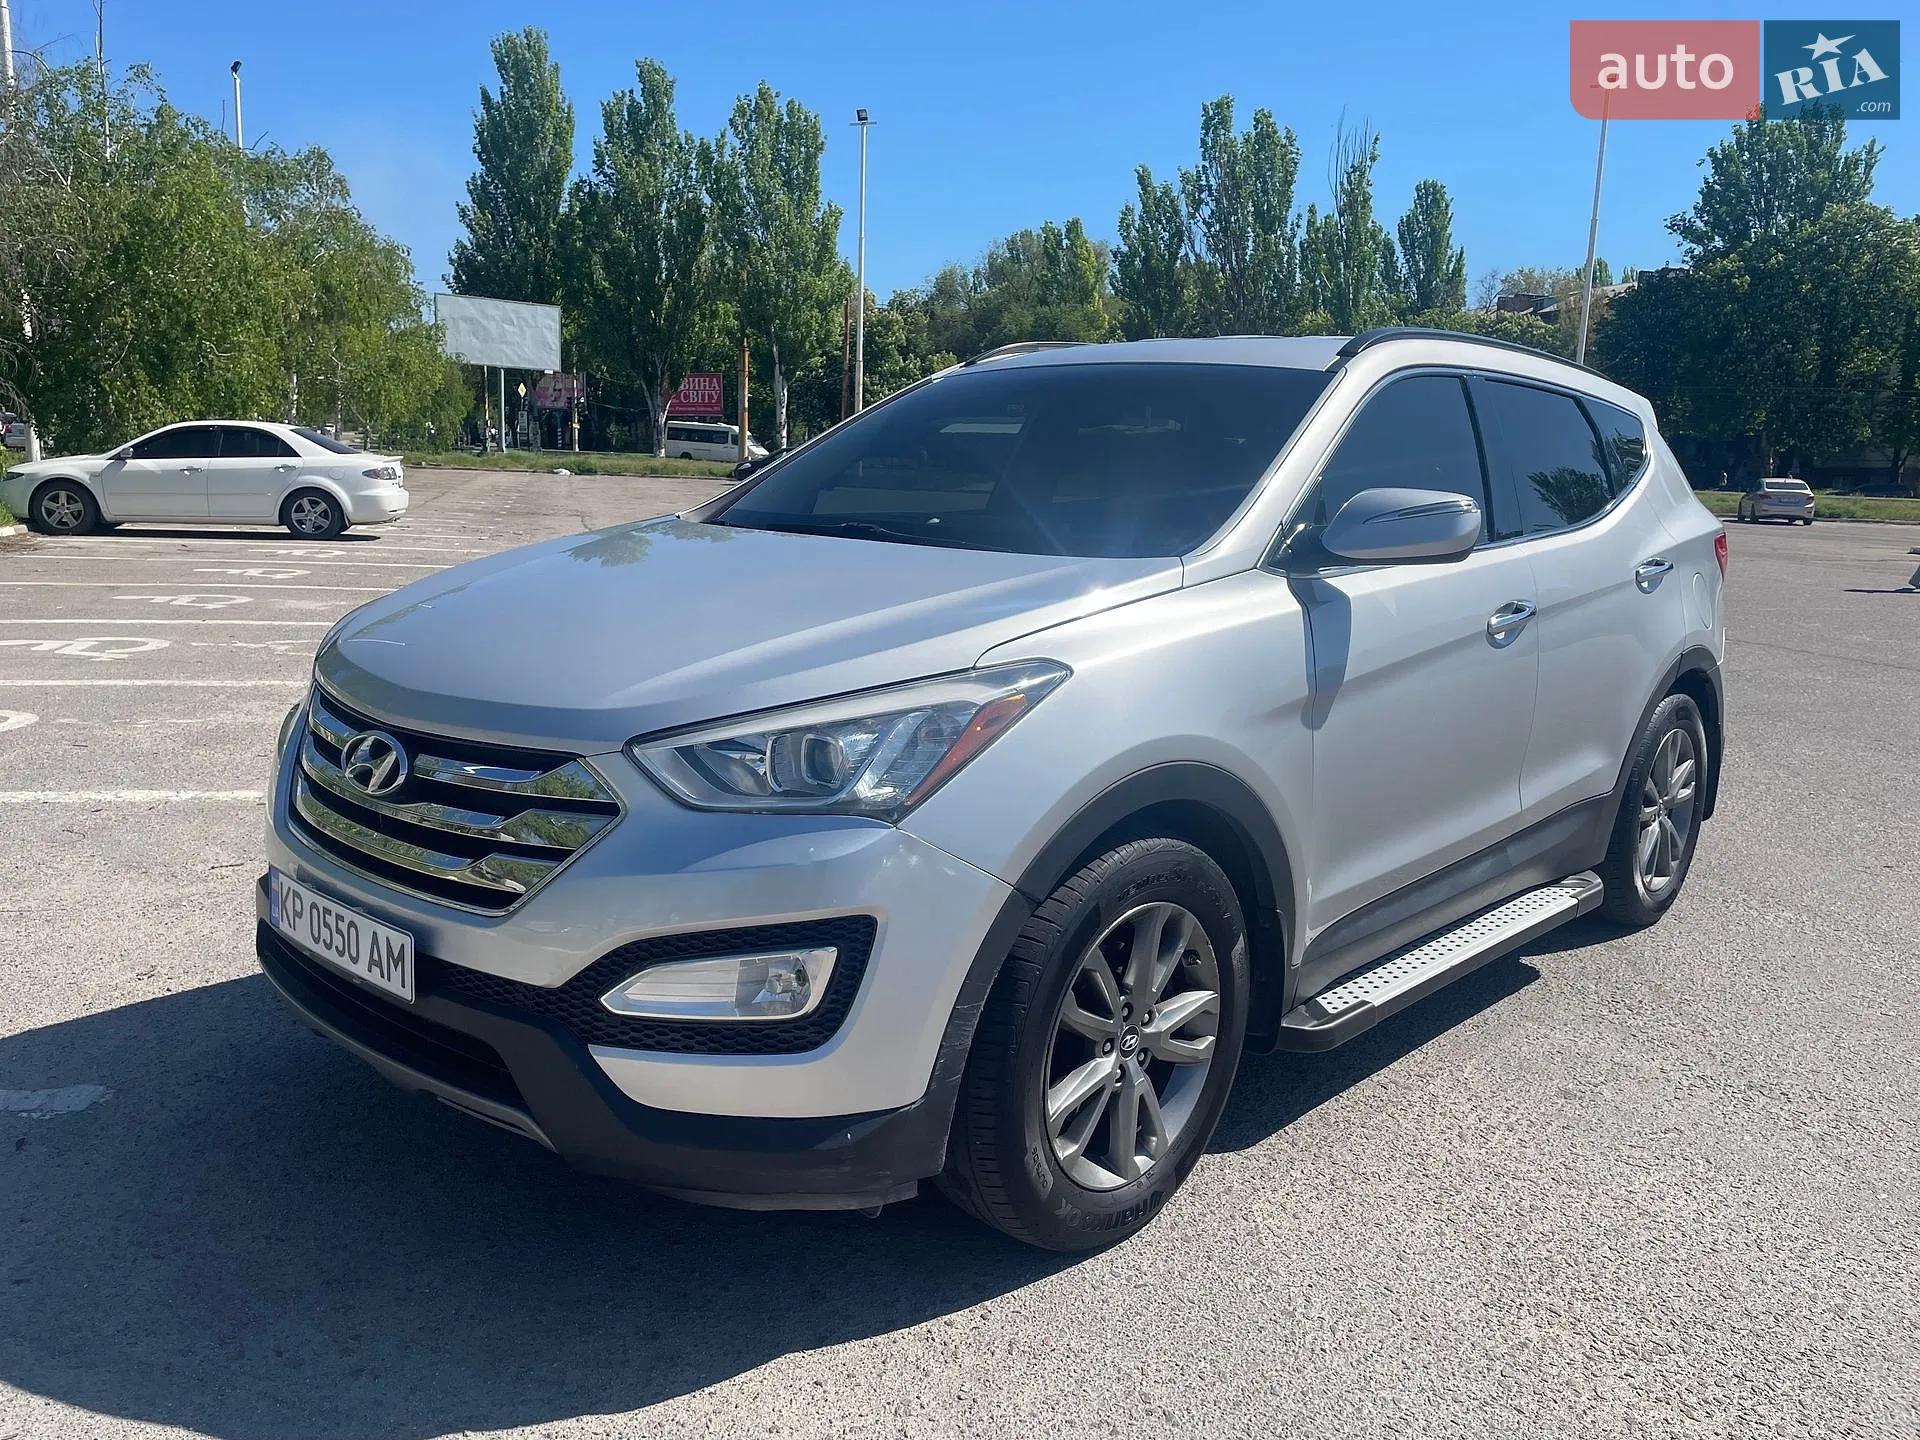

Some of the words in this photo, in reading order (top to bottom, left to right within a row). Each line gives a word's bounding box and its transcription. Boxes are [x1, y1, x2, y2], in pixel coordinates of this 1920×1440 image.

[680, 377, 720, 390] ВИНА
[680, 390, 720, 403] СВІТУ
[280, 881, 304, 932] KP
[309, 901, 360, 965] 0550
[367, 930, 406, 989] AM
